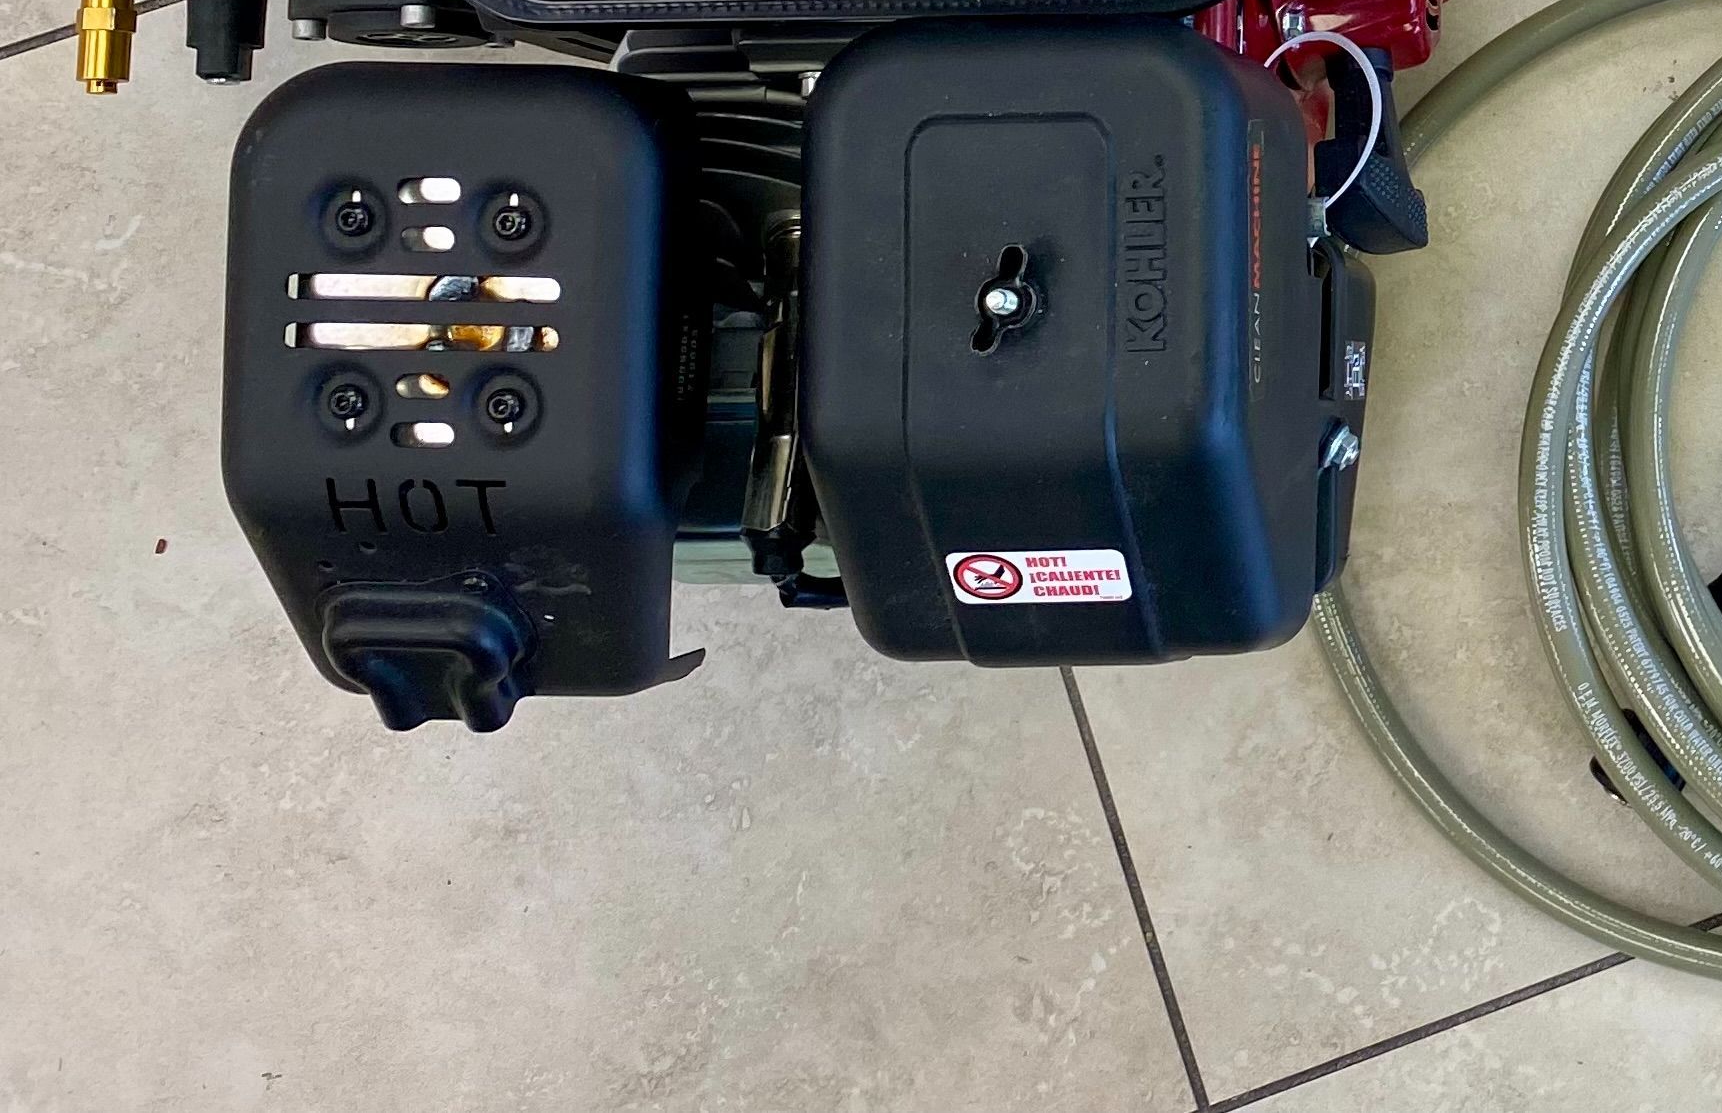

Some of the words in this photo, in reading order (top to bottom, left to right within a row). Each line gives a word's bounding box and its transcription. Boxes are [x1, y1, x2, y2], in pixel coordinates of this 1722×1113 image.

[1249, 143, 1262, 288] MACHINE
[1120, 166, 1170, 352] KOHLER
[1252, 292, 1261, 382] CLEAN
[322, 471, 506, 541] HOT
[1025, 555, 1067, 567] HOT!
[1029, 568, 1120, 584] ¡CALIENTE!
[1033, 584, 1099, 597] CHAUD!
